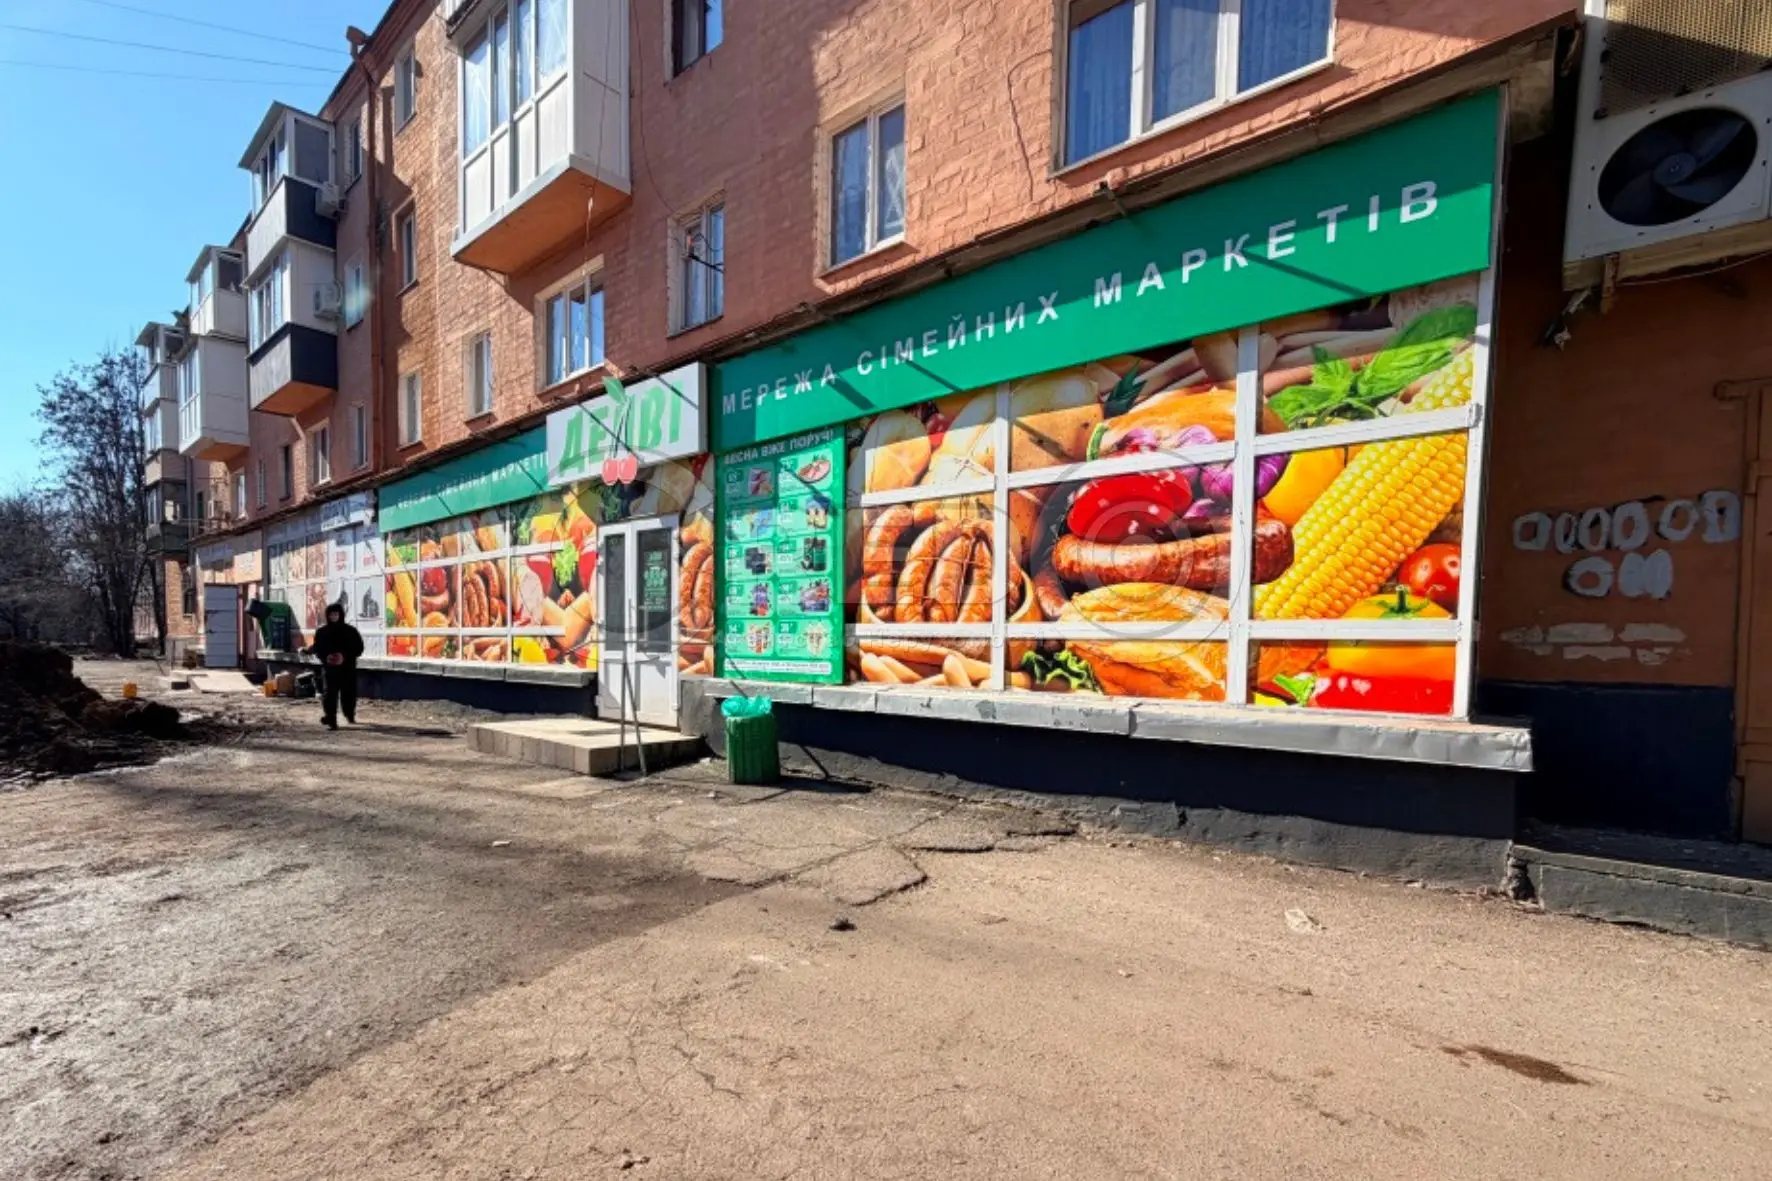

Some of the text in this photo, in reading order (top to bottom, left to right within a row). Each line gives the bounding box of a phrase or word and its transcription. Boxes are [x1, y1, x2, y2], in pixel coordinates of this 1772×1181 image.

[722, 181, 1439, 416] МЕРЕЖА СІМЕЙНИХ МАРКЕТІВ
